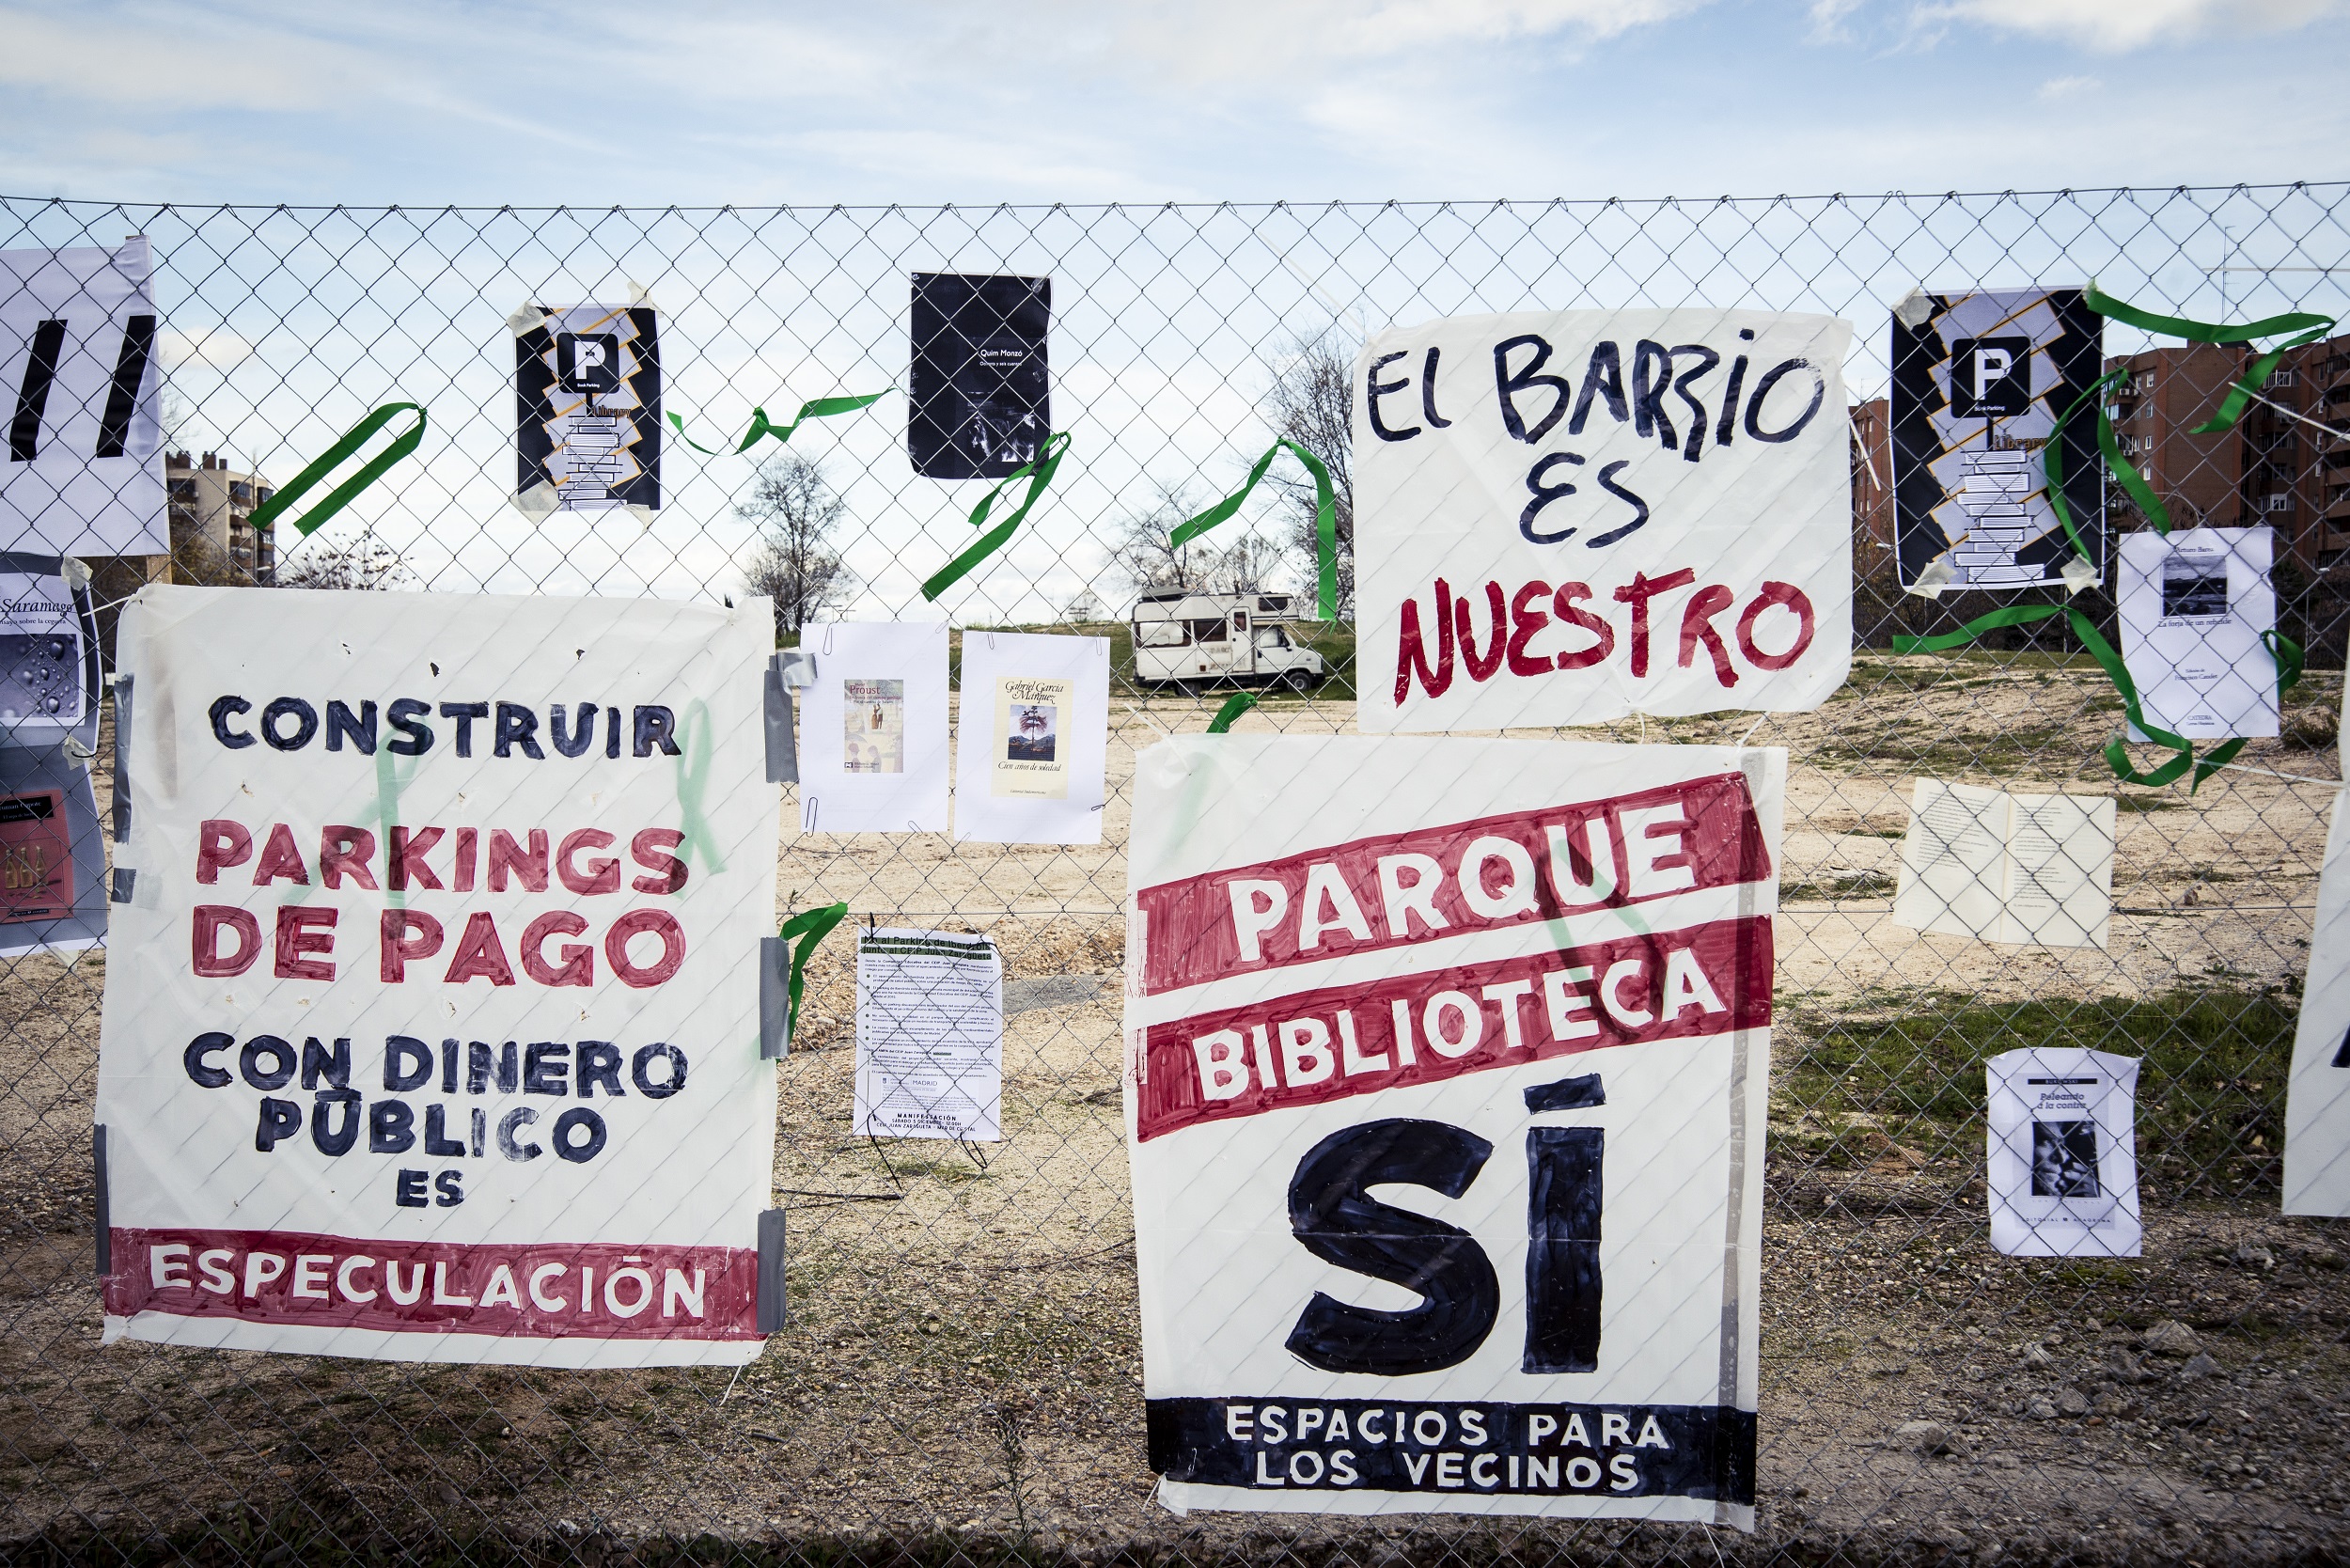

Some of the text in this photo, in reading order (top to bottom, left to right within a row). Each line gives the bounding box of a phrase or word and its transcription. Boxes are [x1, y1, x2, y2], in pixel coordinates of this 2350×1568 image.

[574, 341, 605, 379] P
[980, 349, 998, 357] Quim
[1974, 349, 2013, 400] P
[593, 405, 631, 418] Library
[1994, 434, 2047, 451] Library
[1519, 451, 1650, 548] ES
[1, 598, 72, 617] Saramago
[1393, 567, 1815, 709] NUESTRO
[850, 684, 881, 694] Proust
[1005, 680, 1035, 694] Gabriel
[209, 695, 682, 760] CONSTRUIR
[196, 820, 689, 896] PARKINGS
[1227, 804, 1694, 962] PARQUE
[193, 905, 686, 989] DE PAGO
[862, 946, 885, 954] junto
[900, 947, 922, 955] CEIP
[925, 948, 945, 956] Juan
[948, 949, 992, 960] Zaragüeta
[894, 936, 930, 947] Parking
[1193, 948, 1727, 1100] BIBLIOTECA
[184, 1031, 689, 1099] CON DINERO
[2040, 1092, 2085, 1101] Peleando
[255, 1089, 608, 1163] PÚBLICO
[396, 1168, 464, 1209] ES
[1285, 1073, 1606, 1377] SÍ
[150, 1244, 705, 1318] ESPECULACIÓN
[1226, 1405, 1670, 1450] ESPACIOS PARA
[1256, 1450, 1638, 1491] LOS VECINOS
